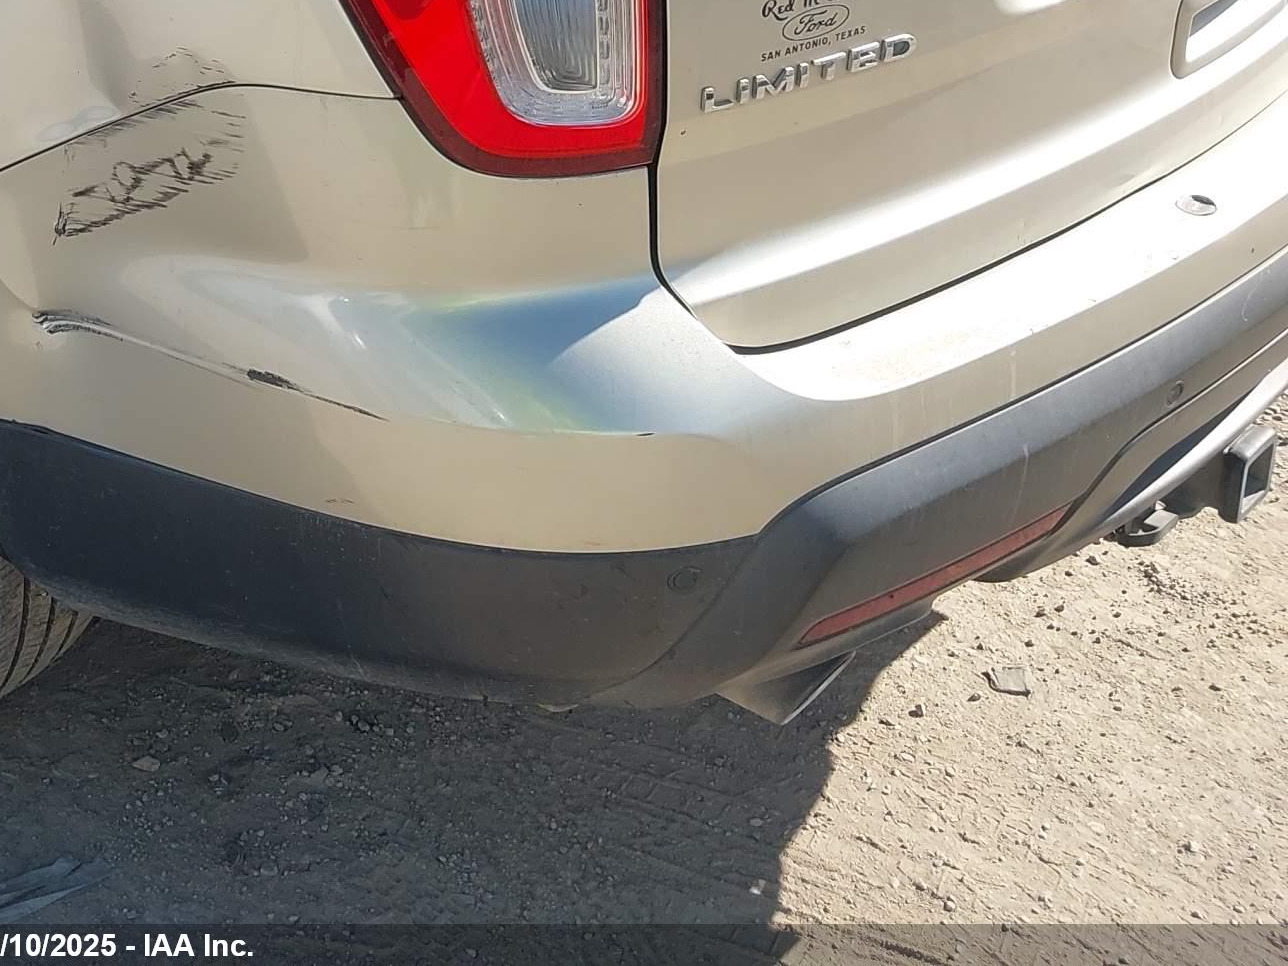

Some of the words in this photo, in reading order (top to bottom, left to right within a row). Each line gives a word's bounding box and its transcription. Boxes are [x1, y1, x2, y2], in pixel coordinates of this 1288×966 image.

[793, 11, 839, 36] Ford
[760, 48, 782, 62] SAN
[784, 36, 833, 56] ANTONIO,
[835, 25, 867, 44] TEXAS
[700, 33, 917, 114] LIMITED
